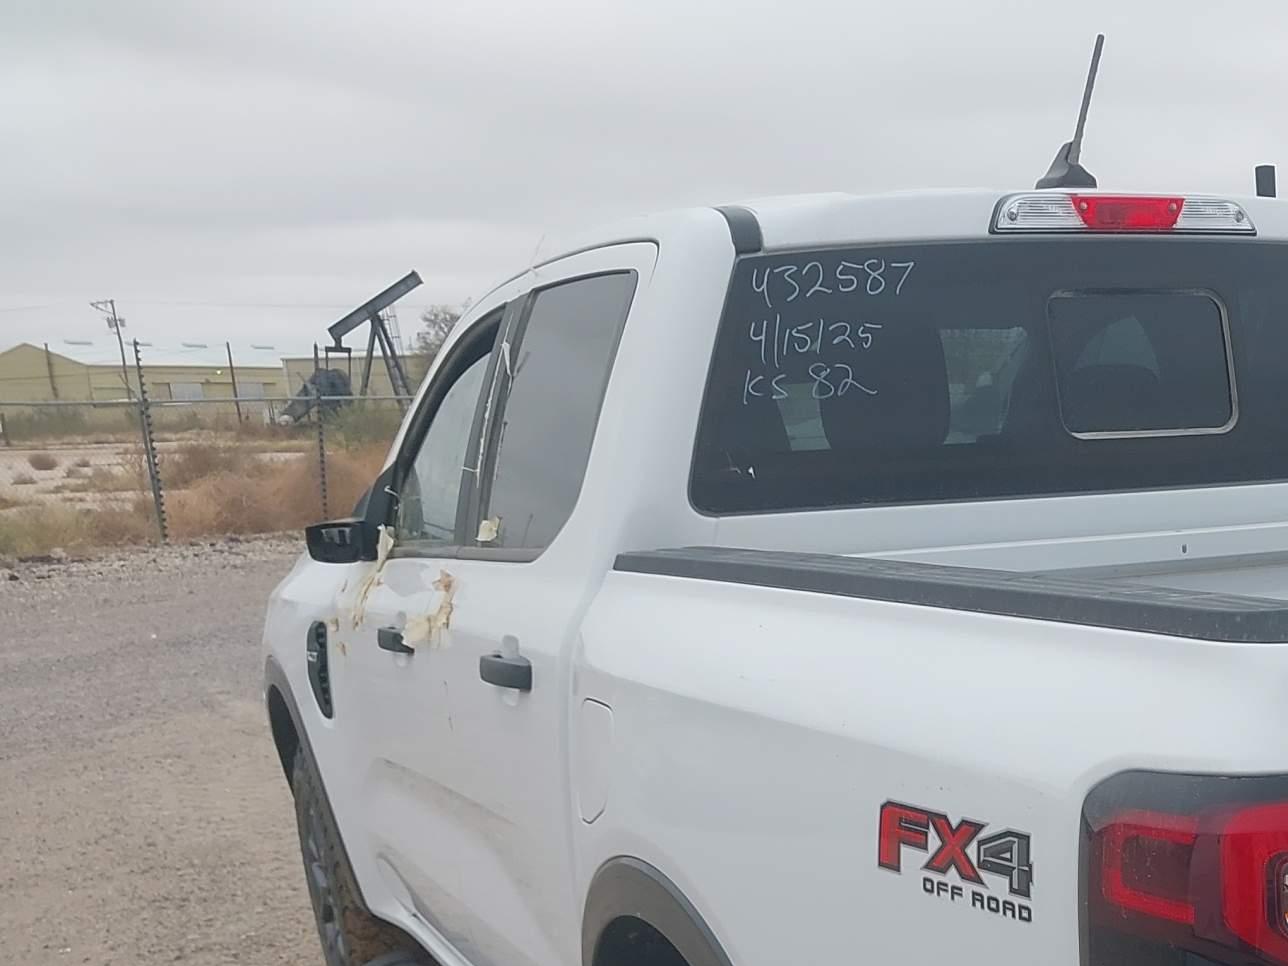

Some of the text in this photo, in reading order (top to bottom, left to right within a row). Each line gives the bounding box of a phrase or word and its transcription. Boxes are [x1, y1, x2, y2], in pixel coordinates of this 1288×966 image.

[751, 258, 915, 308] 432587
[809, 362, 878, 399] 82
[877, 799, 1034, 900] FX4
[922, 876, 1033, 922] OFF ROAD
